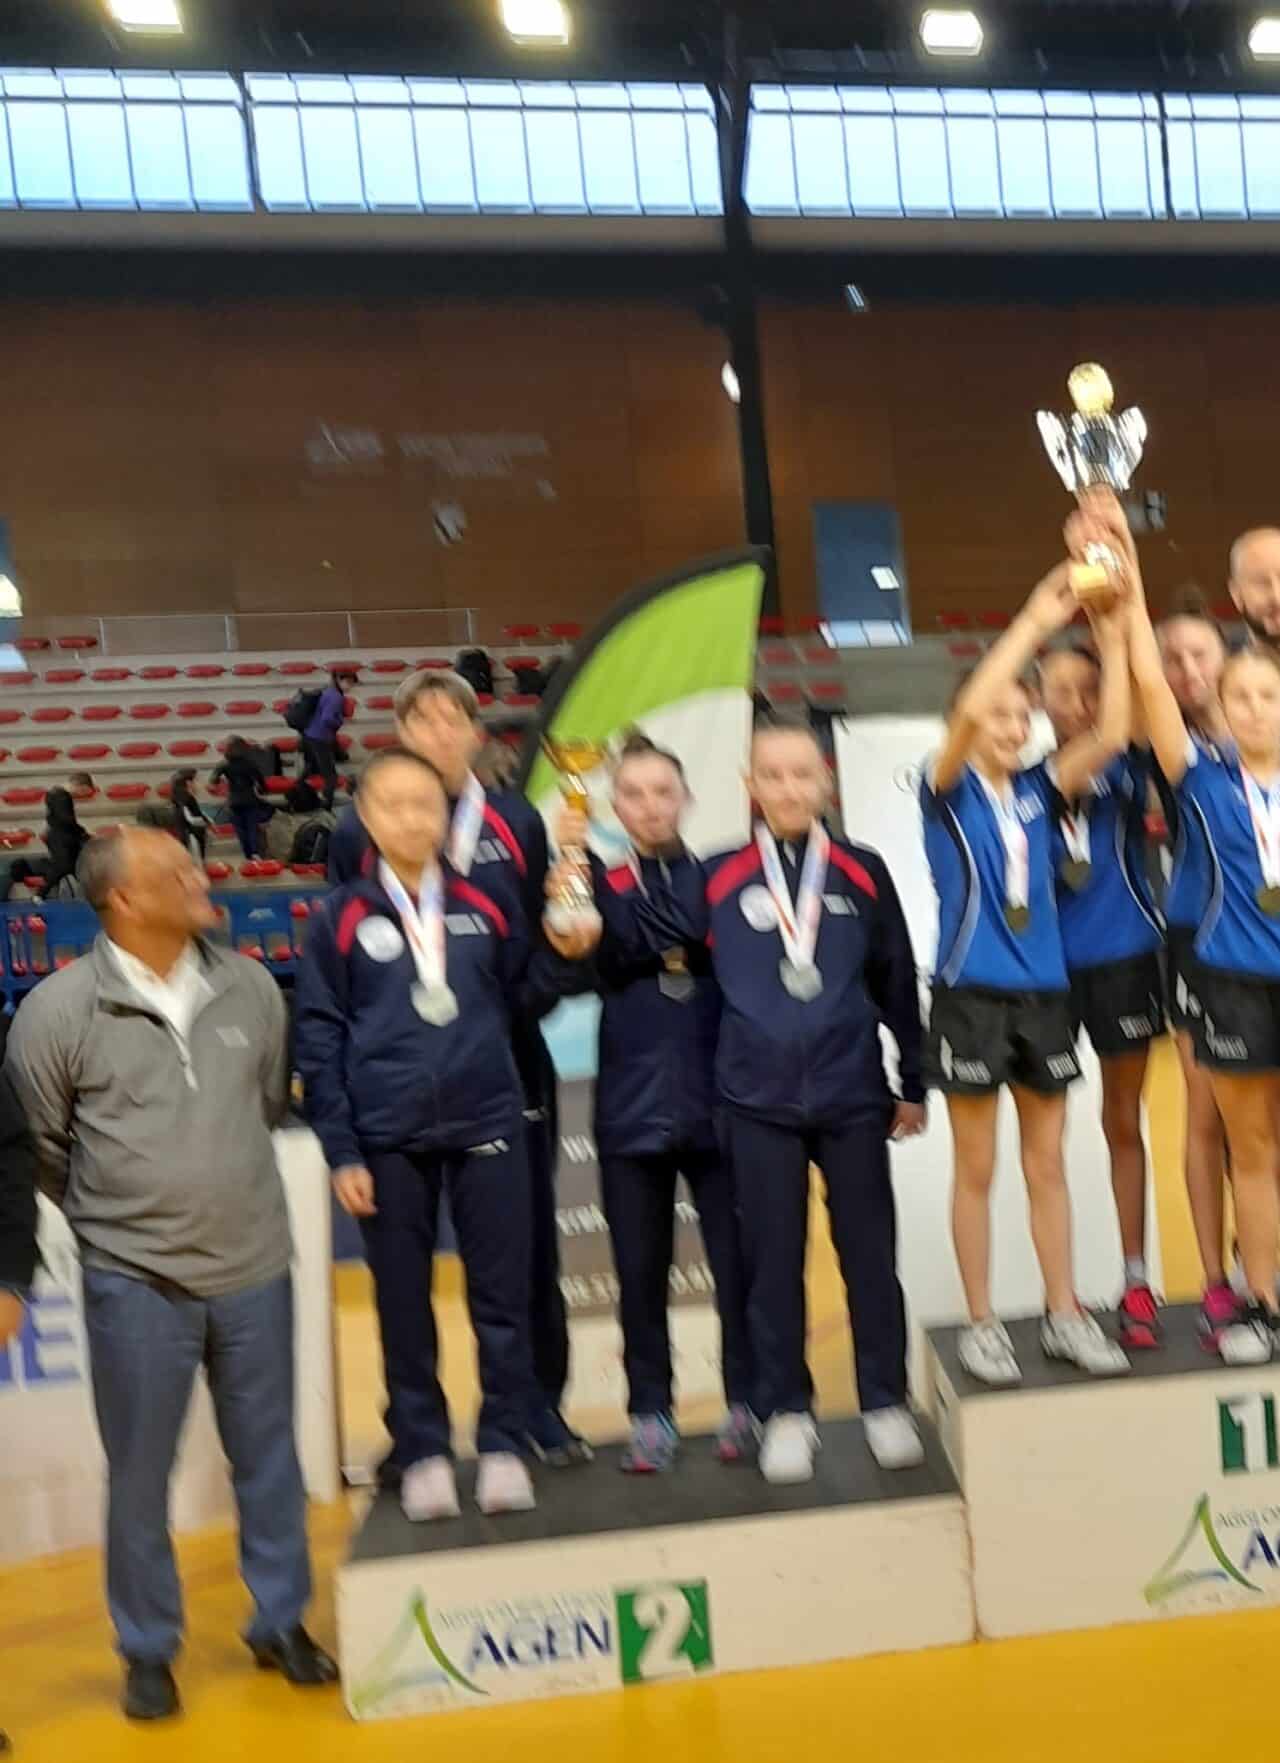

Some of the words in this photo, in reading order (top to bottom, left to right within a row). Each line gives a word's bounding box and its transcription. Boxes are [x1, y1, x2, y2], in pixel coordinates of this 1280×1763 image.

[1227, 1394, 1269, 1472] 1
[465, 1612, 613, 1673] AGEN
[631, 1584, 698, 1679] 2
